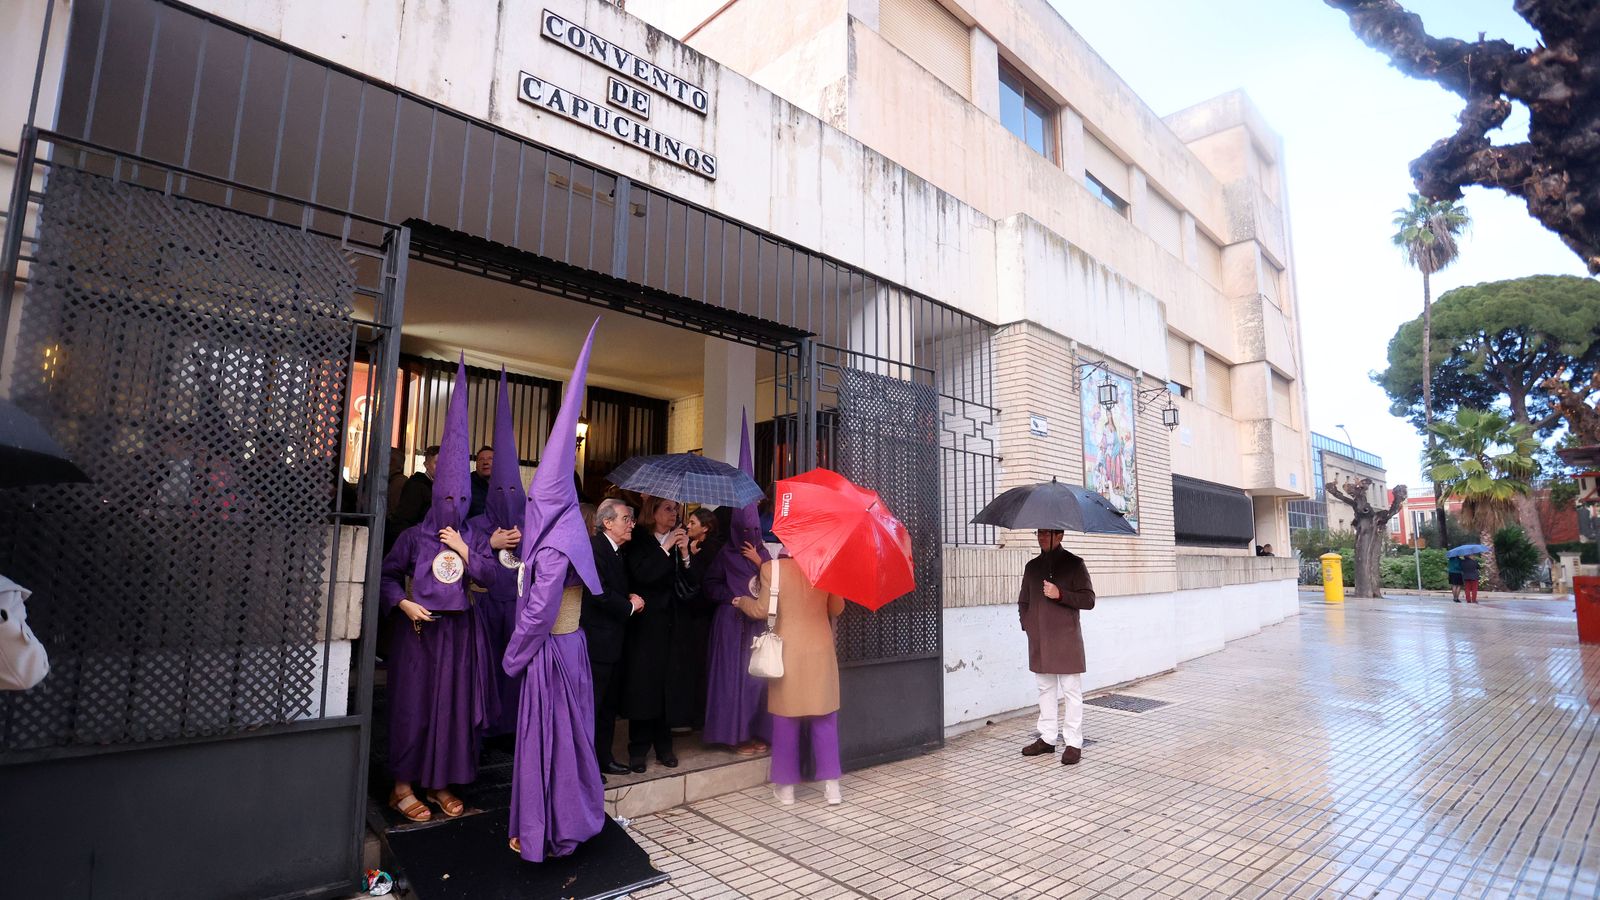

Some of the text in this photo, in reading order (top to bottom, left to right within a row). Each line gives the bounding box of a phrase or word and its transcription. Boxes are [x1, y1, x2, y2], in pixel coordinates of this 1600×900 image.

[545, 15, 707, 110] CONVENTO
[611, 81, 648, 114] DE
[522, 77, 715, 174] CAPUCHINOS
